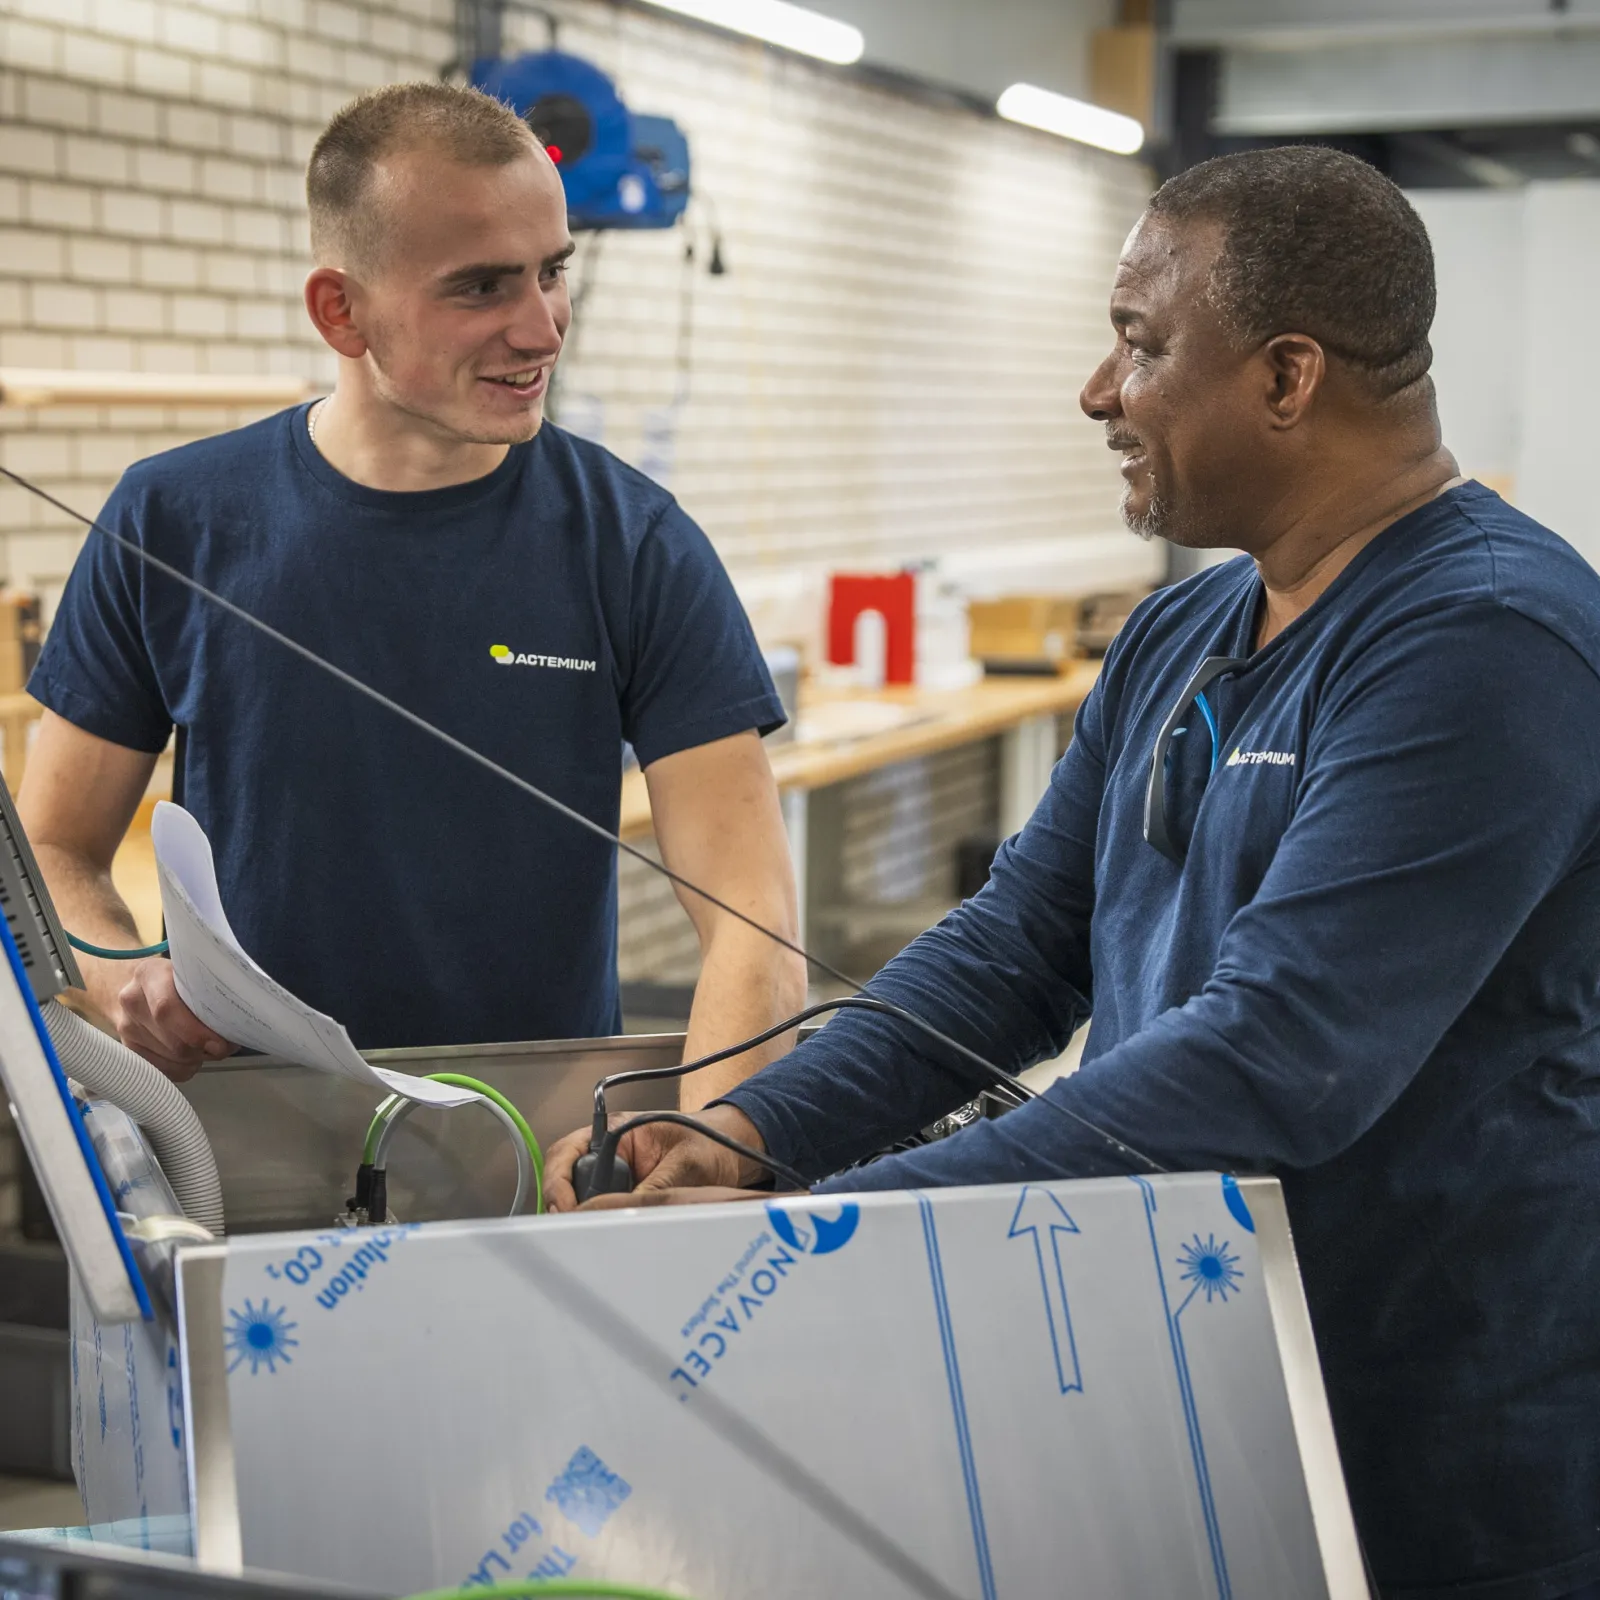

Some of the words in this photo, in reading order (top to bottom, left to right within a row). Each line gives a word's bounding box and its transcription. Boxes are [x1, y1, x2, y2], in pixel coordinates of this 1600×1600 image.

[515, 653, 597, 672] ACTEMIUM
[1237, 751, 1296, 765] ACTEMIUM
[734, 1231, 773, 1276] Beyond
[716, 1272, 741, 1296] The
[669, 1245, 797, 1388] NOVACEL
[681, 1293, 721, 1338] Surface
[501, 1511, 543, 1555] for
